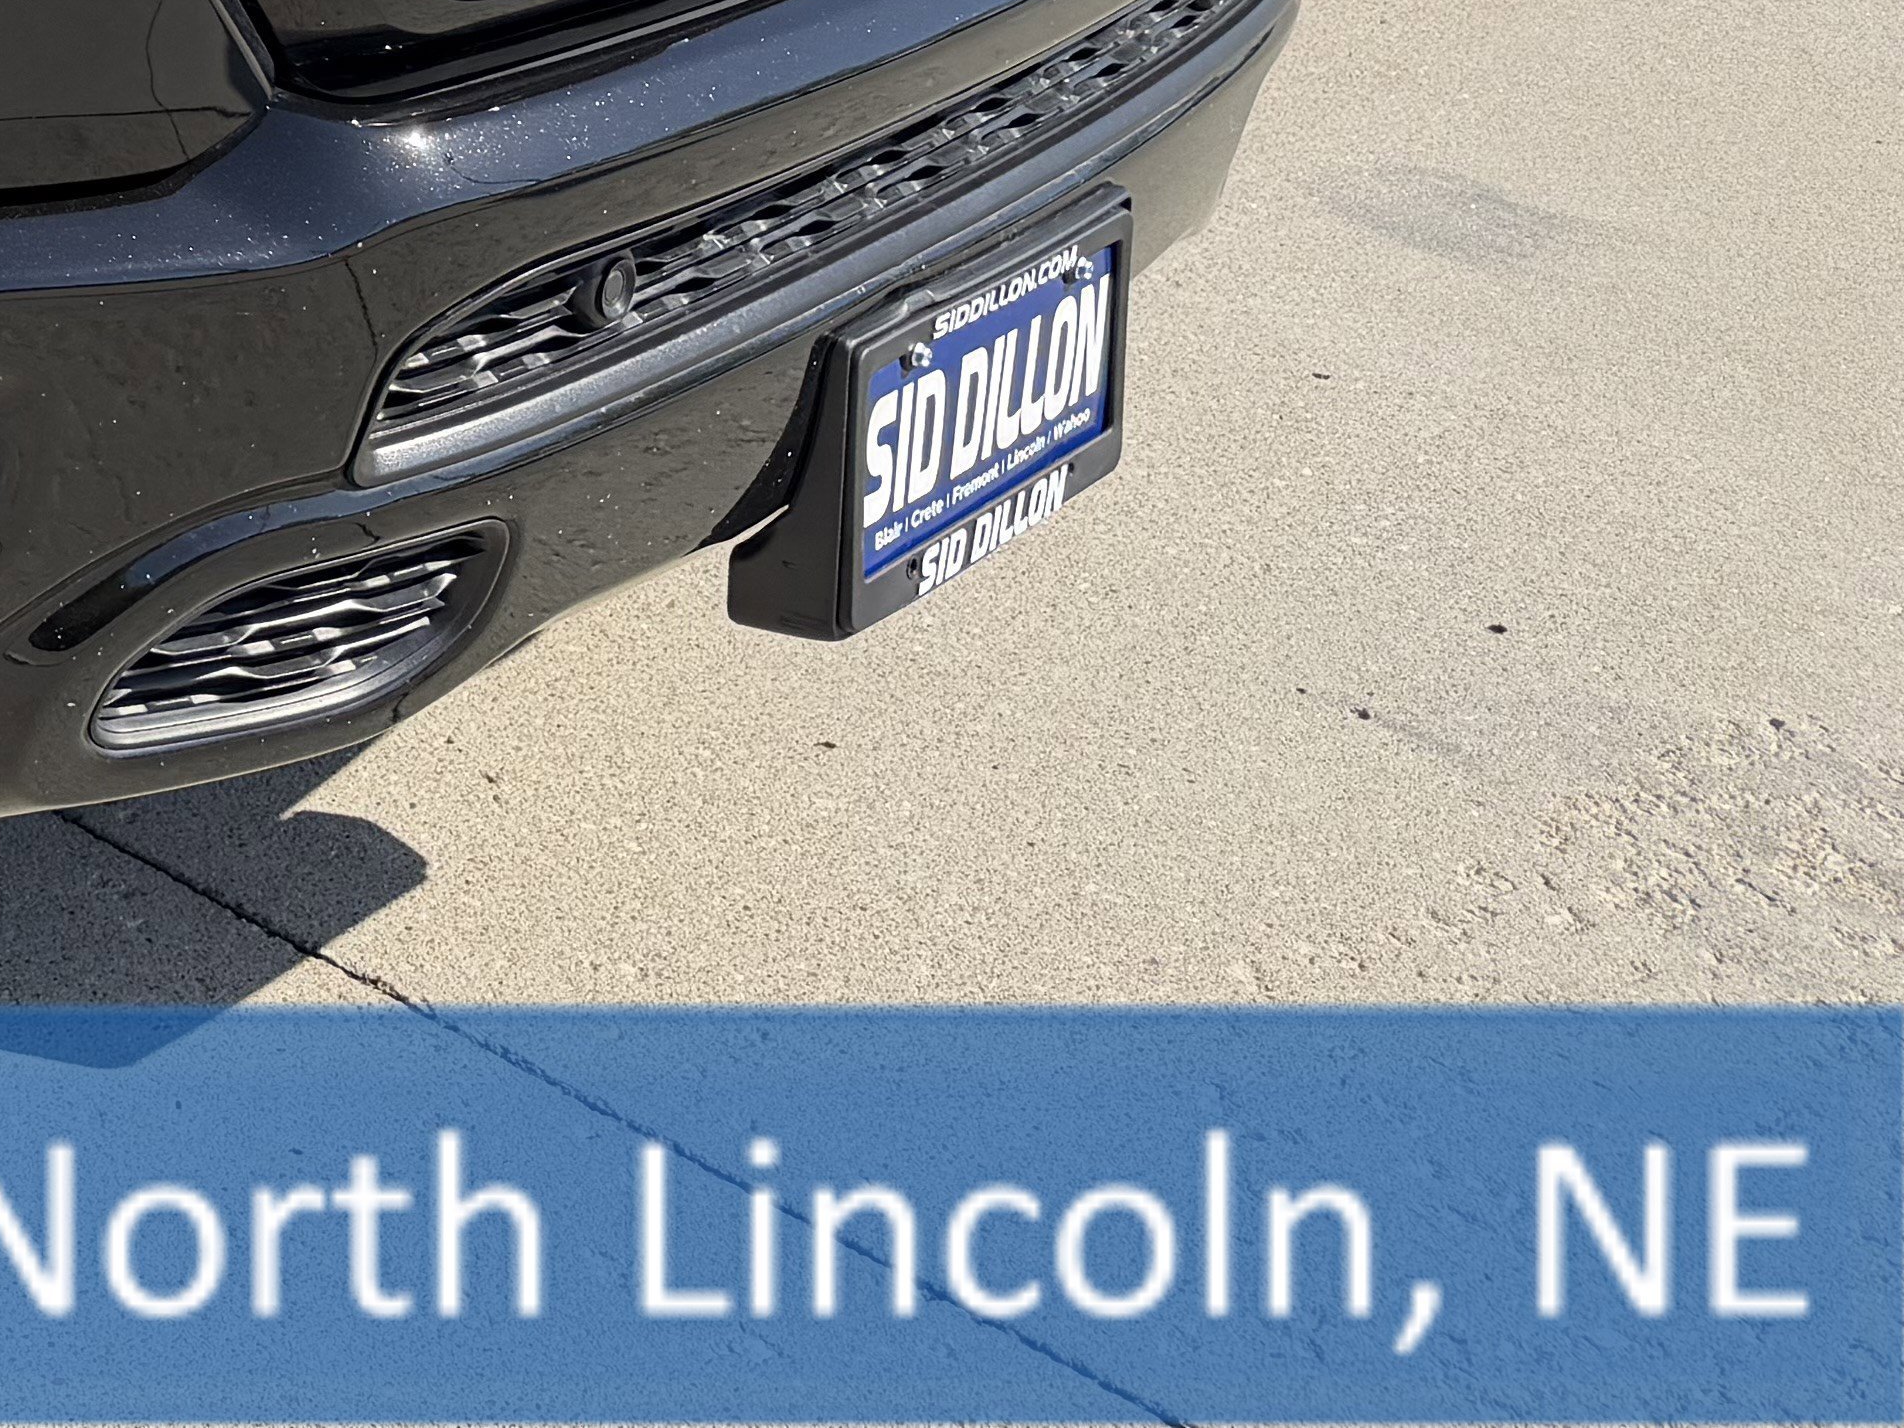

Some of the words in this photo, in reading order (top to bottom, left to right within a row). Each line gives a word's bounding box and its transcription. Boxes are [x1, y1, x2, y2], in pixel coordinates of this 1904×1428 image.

[933, 245, 1078, 339] SIDDILLON.COM
[863, 370, 946, 528] SID
[949, 274, 1110, 481] DILLON
[874, 521, 903, 551] Blair
[910, 497, 944, 529] Crete
[951, 462, 1000, 506] Fremont
[1007, 436, 1046, 471] Lincoln
[1053, 408, 1091, 441] Wahoo
[918, 528, 967, 596] SID
[970, 463, 1069, 564] DILLON
